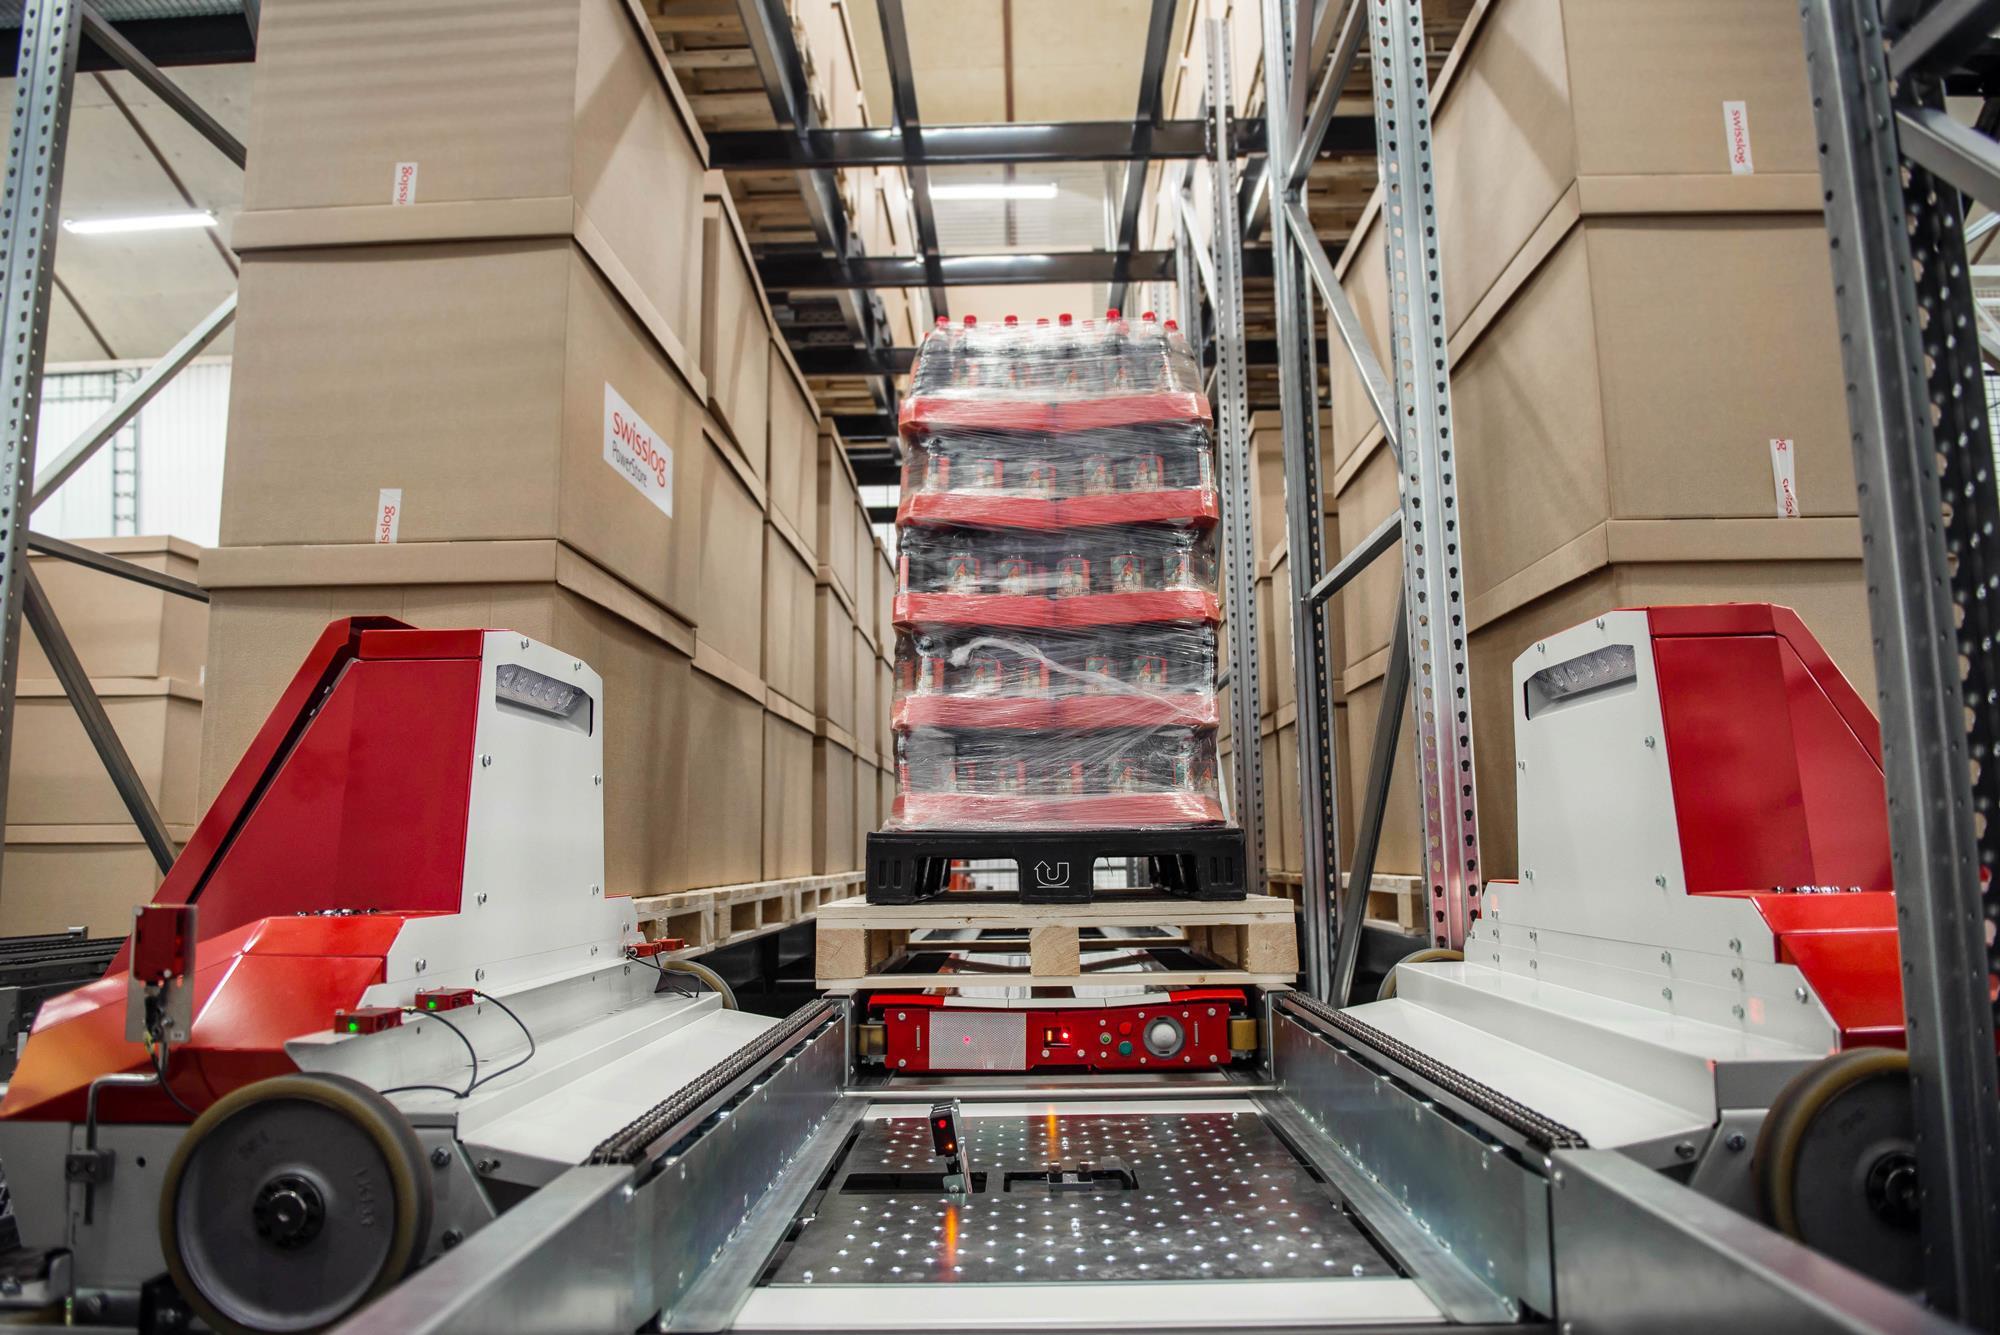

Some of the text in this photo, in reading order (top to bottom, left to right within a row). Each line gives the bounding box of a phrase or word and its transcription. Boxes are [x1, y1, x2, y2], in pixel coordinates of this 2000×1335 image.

[1732, 109, 1746, 164] swisslog
[612, 440, 648, 488] PowerStore
[613, 411, 666, 488] swisslog
